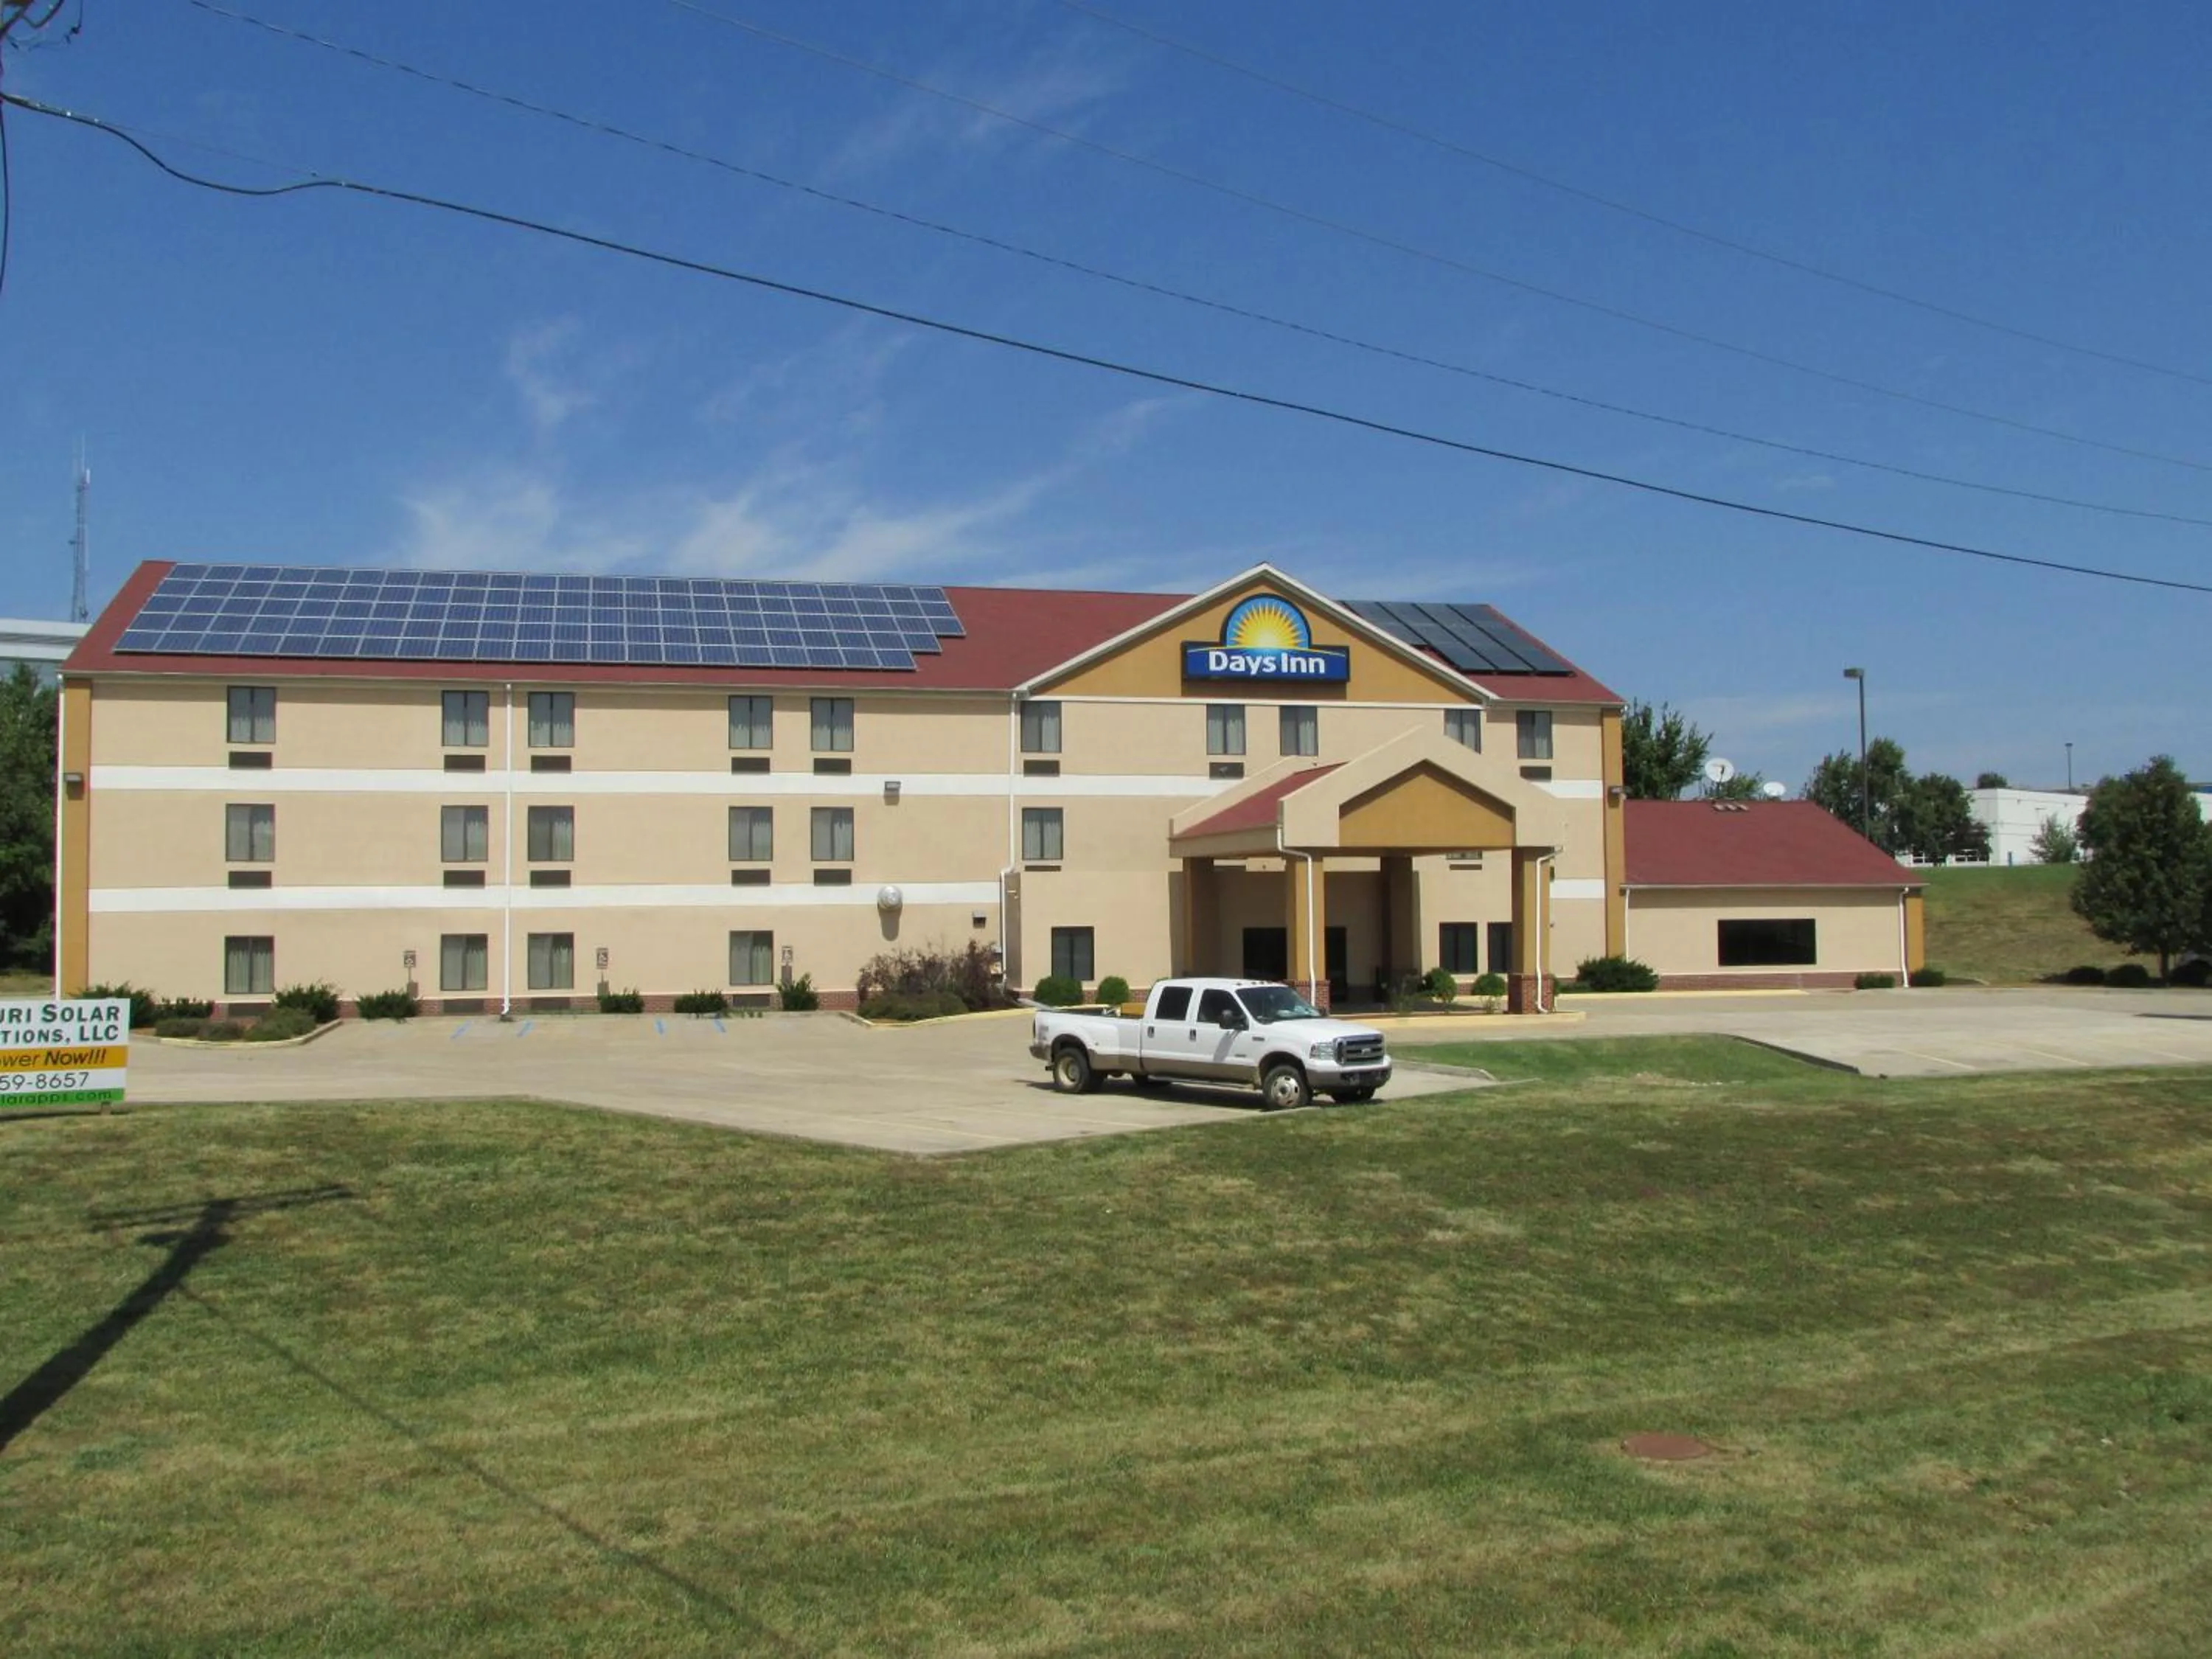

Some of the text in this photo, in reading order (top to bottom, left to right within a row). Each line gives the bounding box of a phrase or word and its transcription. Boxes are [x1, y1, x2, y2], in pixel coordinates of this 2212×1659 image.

[1208, 650, 1325, 675] Days Inn
[41, 1004, 120, 1023] SOLAR
[0, 1025, 119, 1043] TIONS, LLC
[0, 1054, 40, 1068] wer
[0, 1072, 89, 1091] 59-8657
